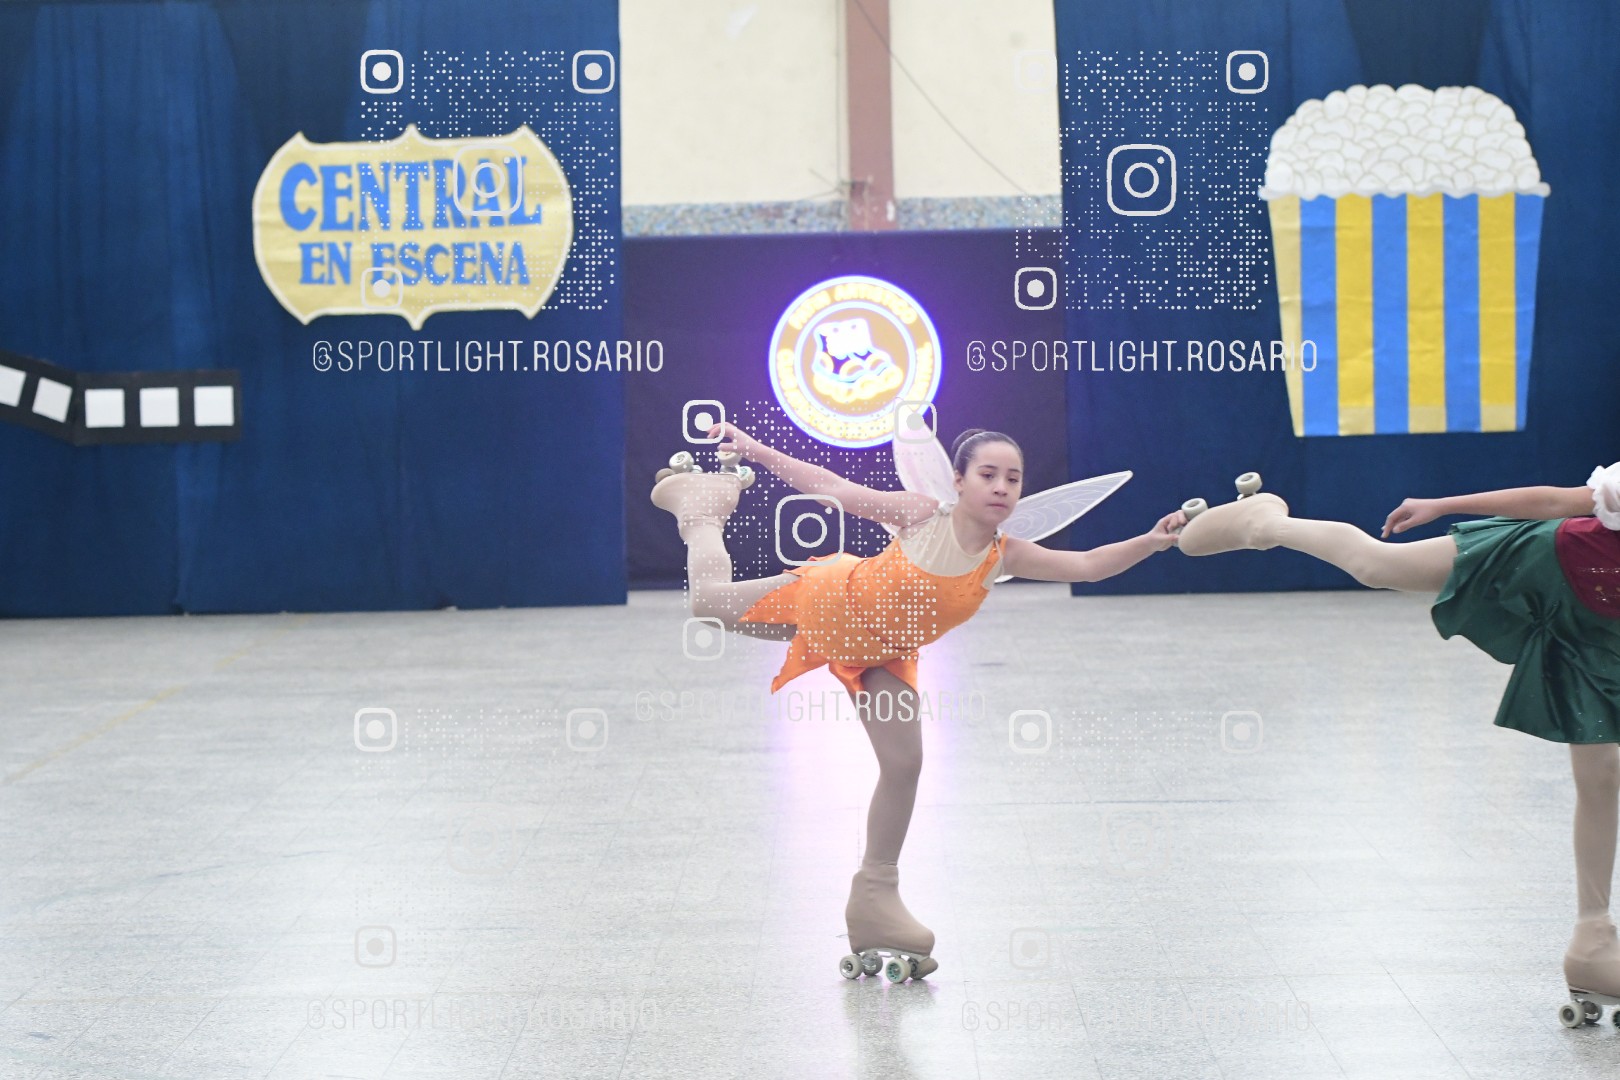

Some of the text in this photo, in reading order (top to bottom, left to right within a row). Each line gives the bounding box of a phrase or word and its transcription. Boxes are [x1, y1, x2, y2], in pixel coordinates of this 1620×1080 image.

[279, 156, 542, 232] CENTRAL
[298, 242, 531, 286] EN ESCENA
